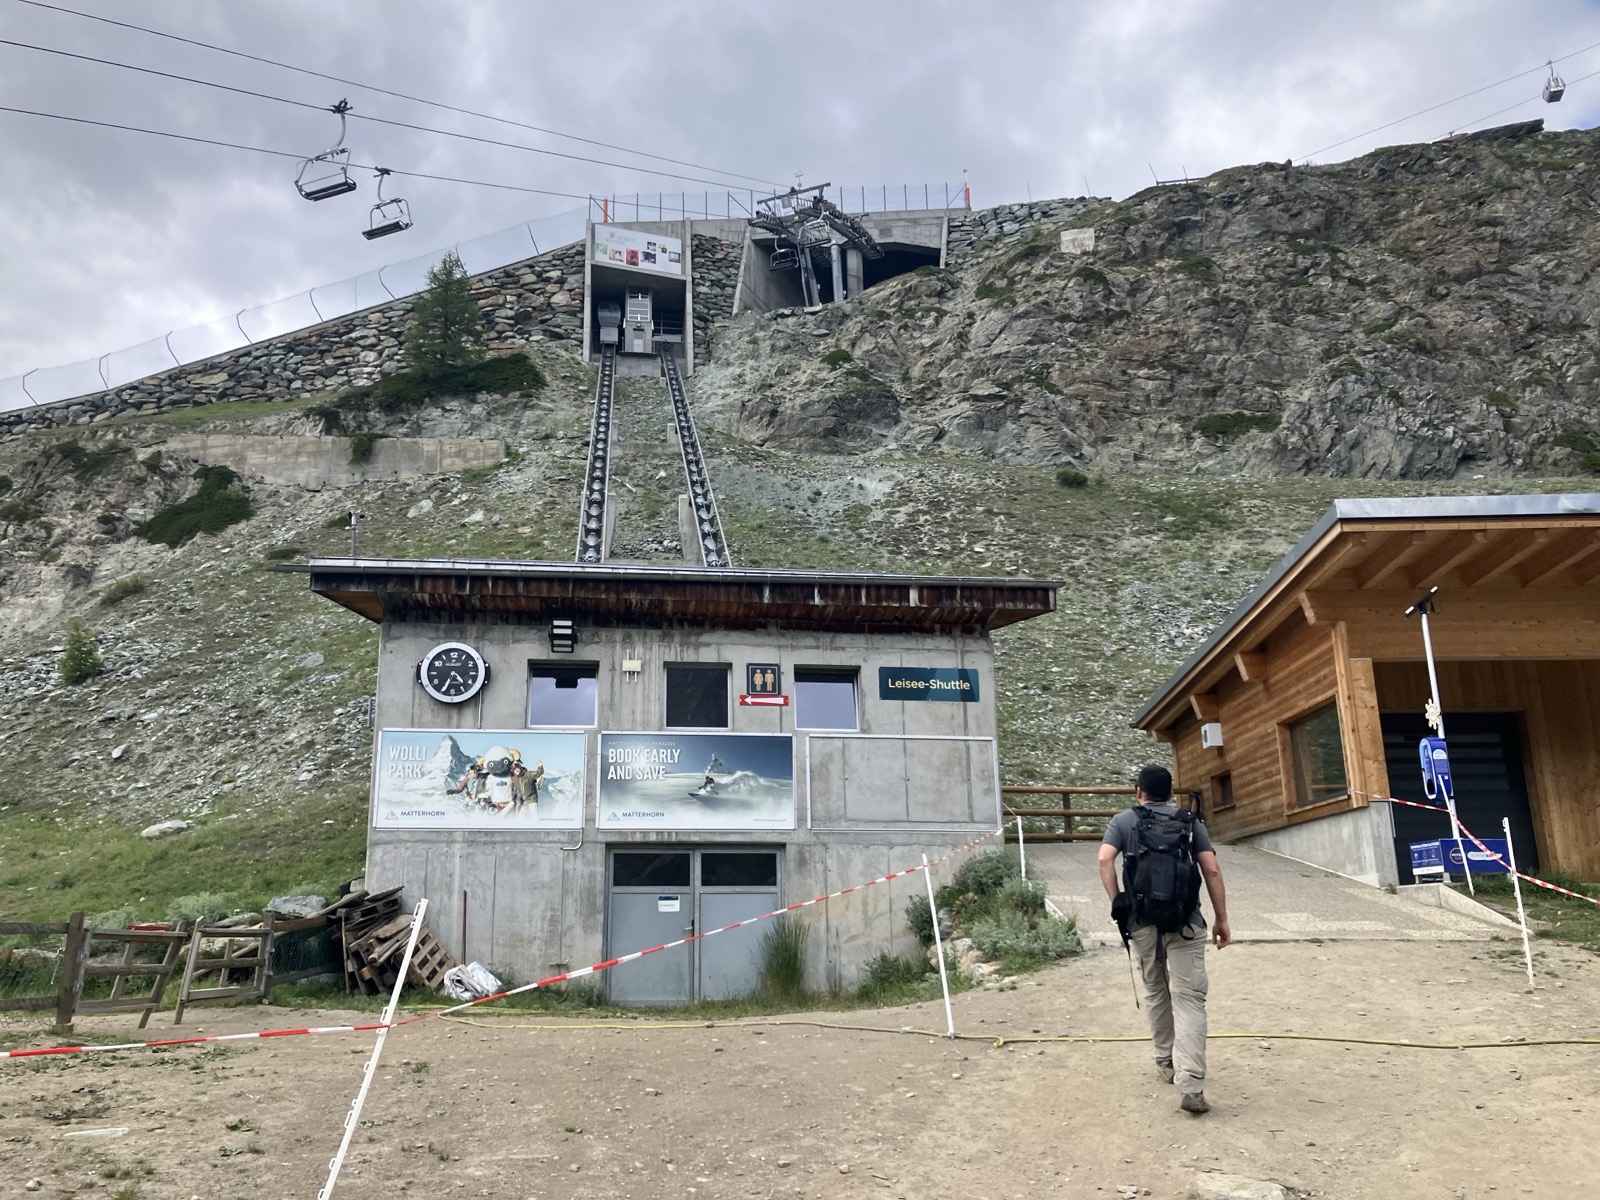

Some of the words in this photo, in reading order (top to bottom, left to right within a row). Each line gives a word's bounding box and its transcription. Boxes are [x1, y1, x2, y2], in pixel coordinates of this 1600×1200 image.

[888, 678, 970, 690] Leisee-Shuttle
[389, 746, 426, 761] WOLLI
[608, 748, 641, 763] BOOK
[644, 748, 680, 763] EARLY
[389, 764, 422, 778] PARK
[607, 765, 632, 780] AND
[636, 765, 666, 780] SAVE
